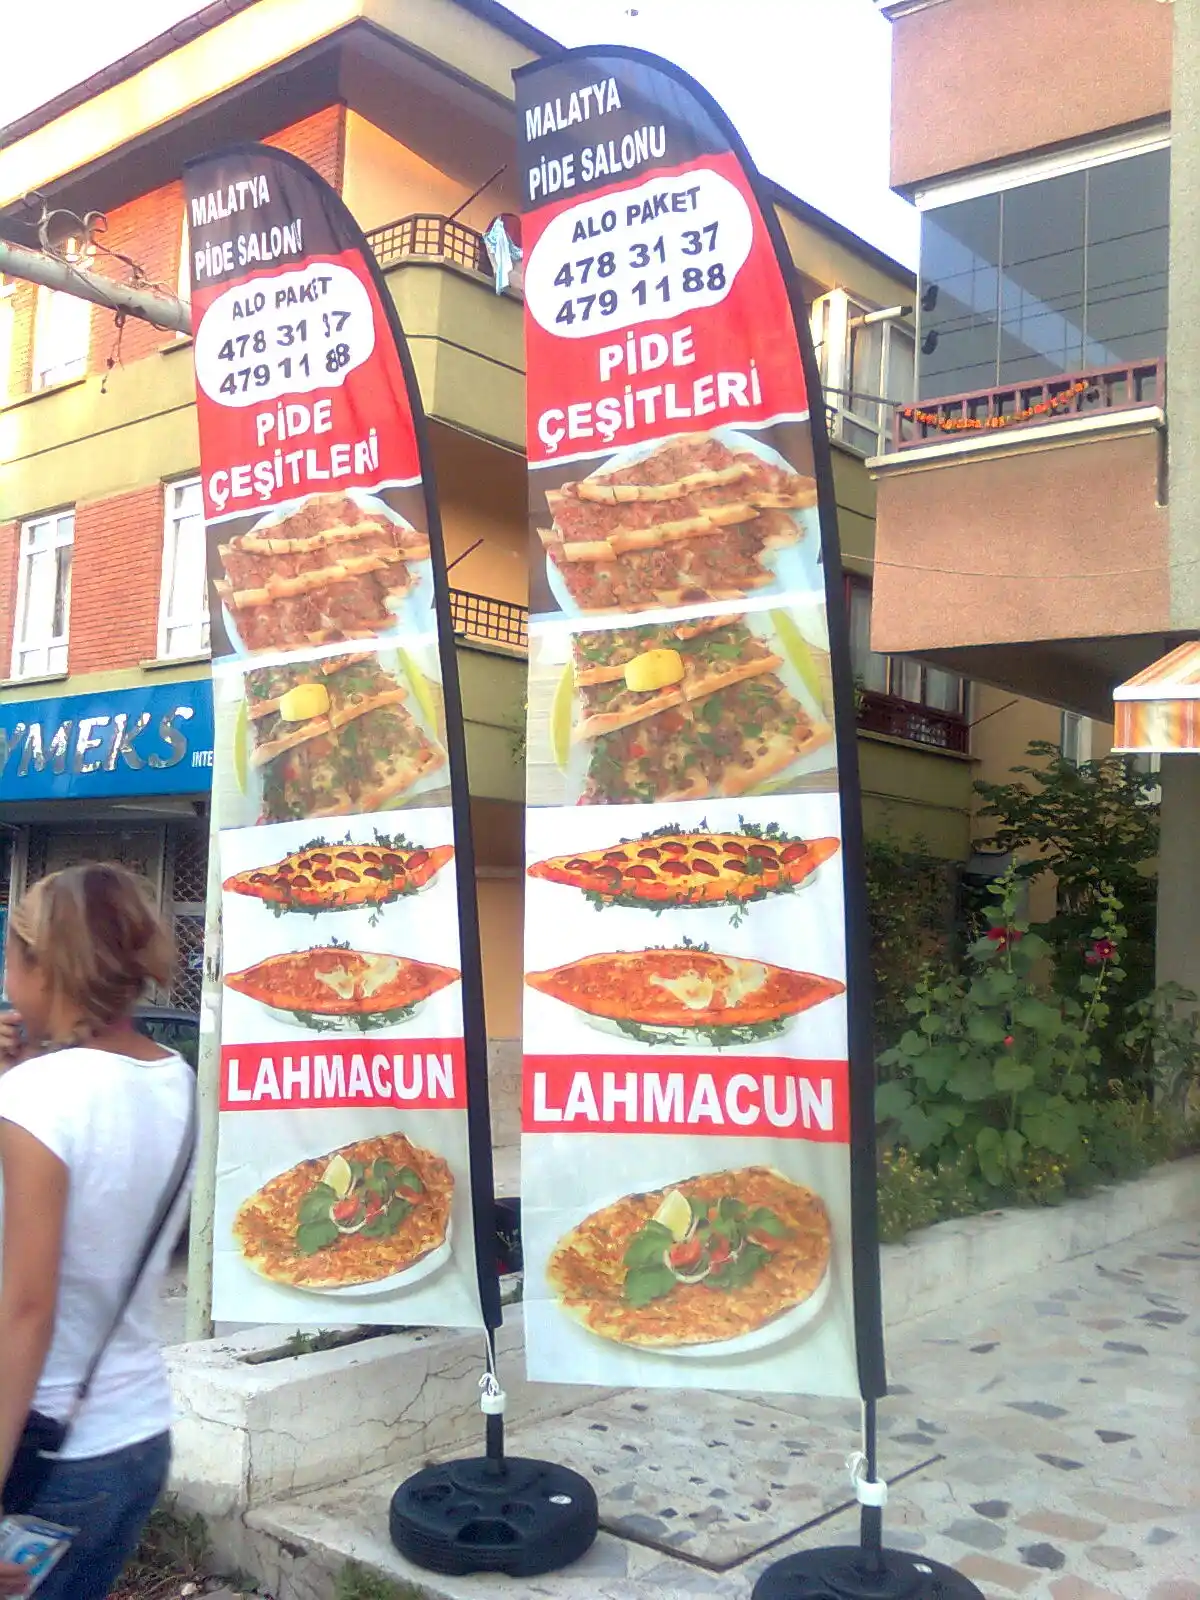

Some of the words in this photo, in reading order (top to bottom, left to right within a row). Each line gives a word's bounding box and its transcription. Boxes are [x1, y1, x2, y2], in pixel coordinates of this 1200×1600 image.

[525, 77, 622, 142] MALATYA
[528, 156, 575, 201] PİDE
[581, 125, 666, 186] SALONU
[192, 174, 270, 228] MALATYA
[572, 211, 617, 243] ALO
[626, 187, 701, 227] PAKET
[194, 240, 235, 281] PİDE
[553, 250, 616, 288] 478
[629, 236, 667, 268] 31
[681, 221, 720, 255] 37
[232, 292, 265, 320] ALO
[275, 276, 332, 308] PAKT
[555, 290, 618, 326] 479
[631, 275, 671, 306] 11
[681, 263, 727, 294] 88
[218, 330, 267, 363] 478
[276, 319, 308, 347] 31
[219, 364, 270, 395] 479
[277, 353, 310, 379] 11
[325, 342, 351, 373] 88
[600, 326, 696, 382] PİDE
[256, 399, 332, 447] PİDE
[537, 359, 763, 454] ÇEŞİTLERİ
[208, 427, 379, 510] ÇEŞİTLERİ
[227, 1053, 455, 1103] LAHMACUN
[533, 1071, 835, 1131] LAHMACUN
